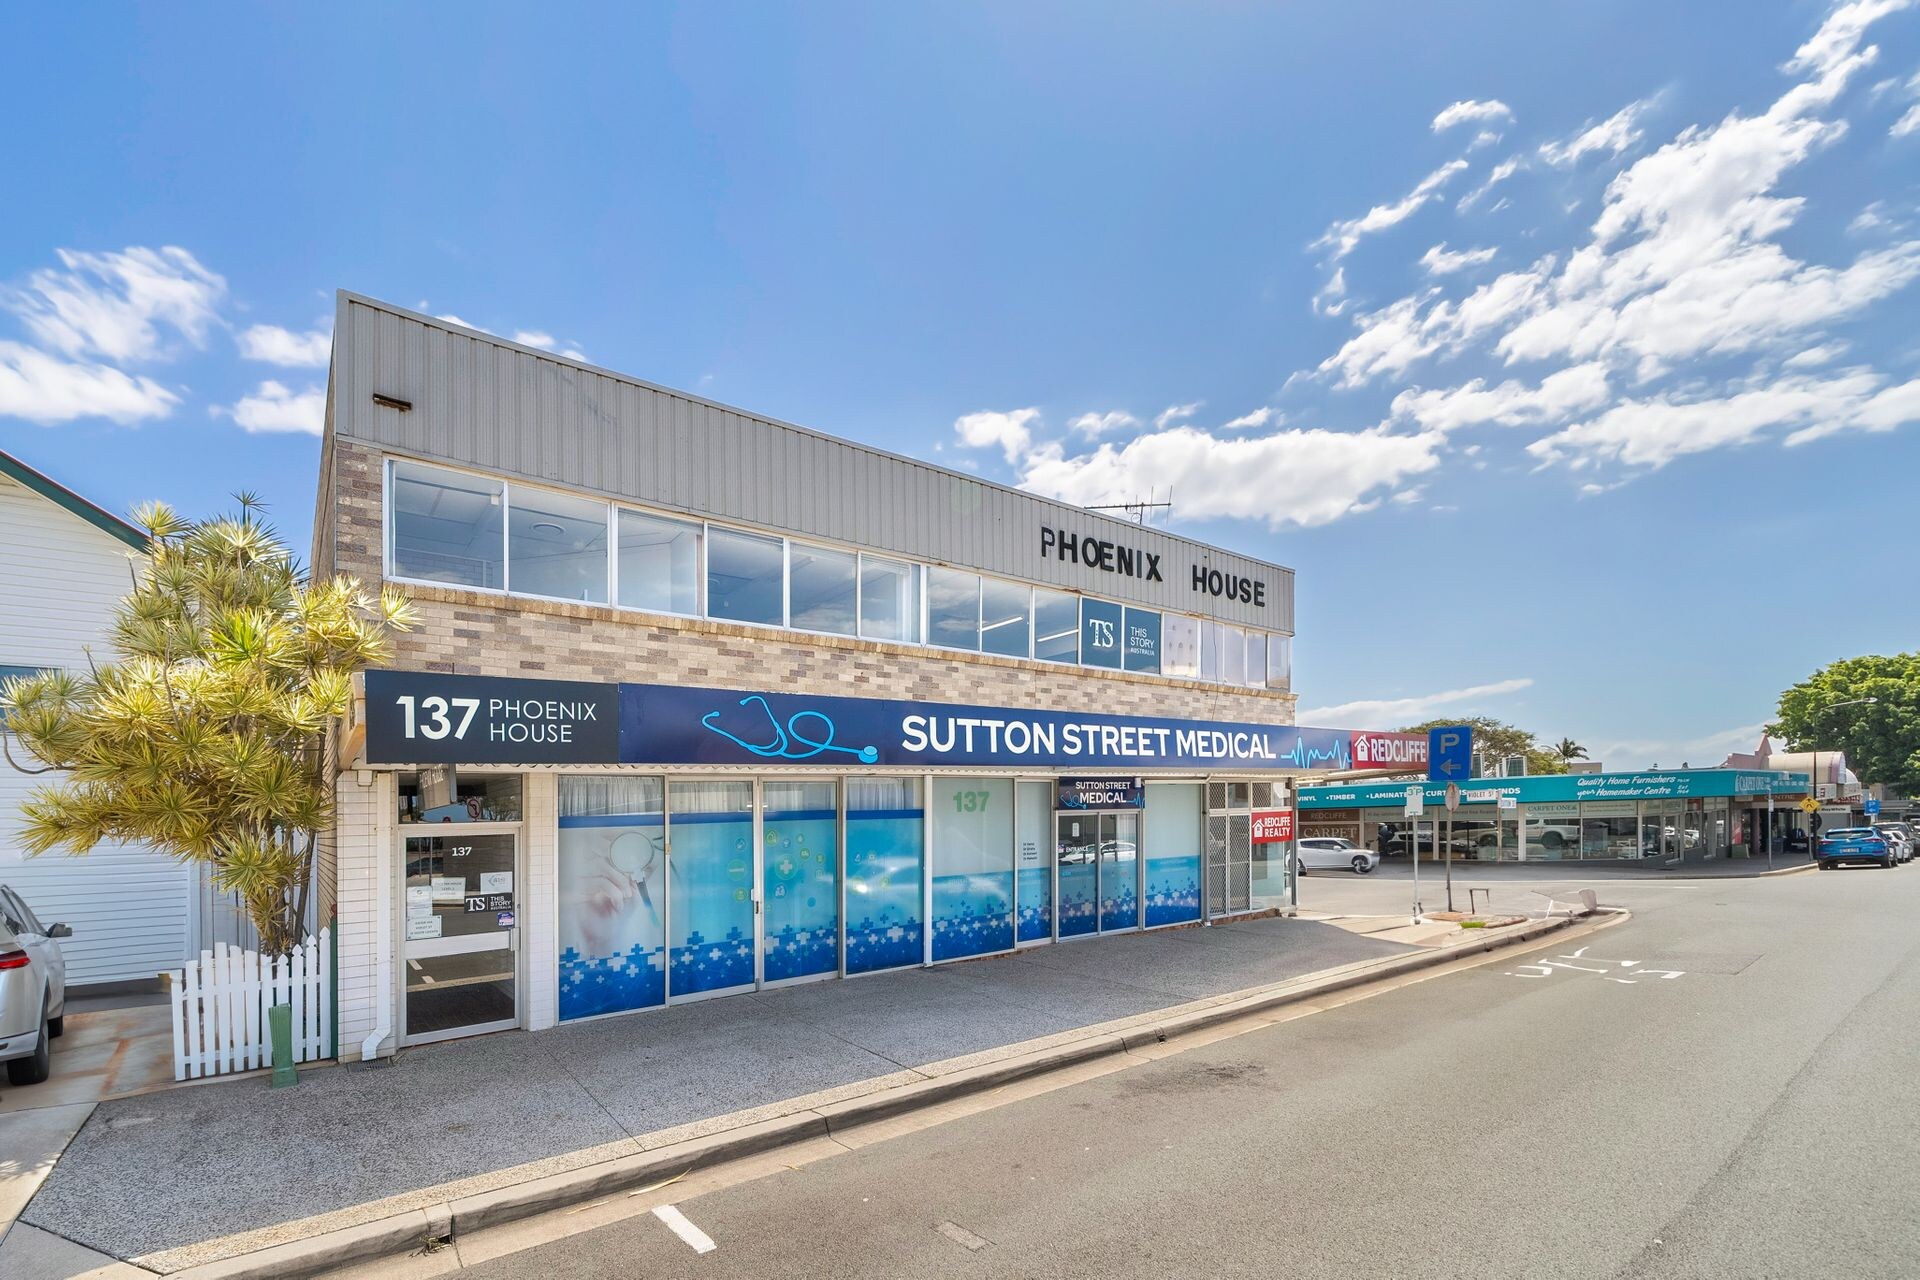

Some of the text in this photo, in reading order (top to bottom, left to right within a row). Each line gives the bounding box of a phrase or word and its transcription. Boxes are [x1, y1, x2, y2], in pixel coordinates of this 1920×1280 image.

[1041, 526, 1265, 607] PHOENIX HOUSE
[1089, 619, 1114, 648] TS
[1130, 626, 1148, 638] THIS
[1130, 637, 1155, 649] STORY
[489, 699, 597, 721] PHOENIX
[396, 696, 481, 740] 137
[490, 723, 573, 743] HOUSE
[902, 715, 1277, 759] SUTTON STREET MEDICAL
[1371, 738, 1426, 763] REDCLIFFE
[1441, 734, 1460, 754] P
[1075, 781, 1131, 790] SUTTON STREET
[1577, 777, 1606, 787] Quality
[1607, 777, 1630, 785] Home
[1632, 775, 1677, 784] Furnishers
[1080, 792, 1127, 804] MEDICAL
[1425, 789, 1467, 797] CURTS
[1577, 786, 1671, 800] your Homemaker Centre
[953, 791, 990, 812] 137
[1264, 816, 1291, 827] REDCLIFFE
[1310, 811, 1347, 819] REDCLIFFE
[1264, 827, 1291, 838] REALTY
[1303, 827, 1358, 838] CARPET
[451, 847, 472, 857] 137
[465, 897, 486, 912] TS
